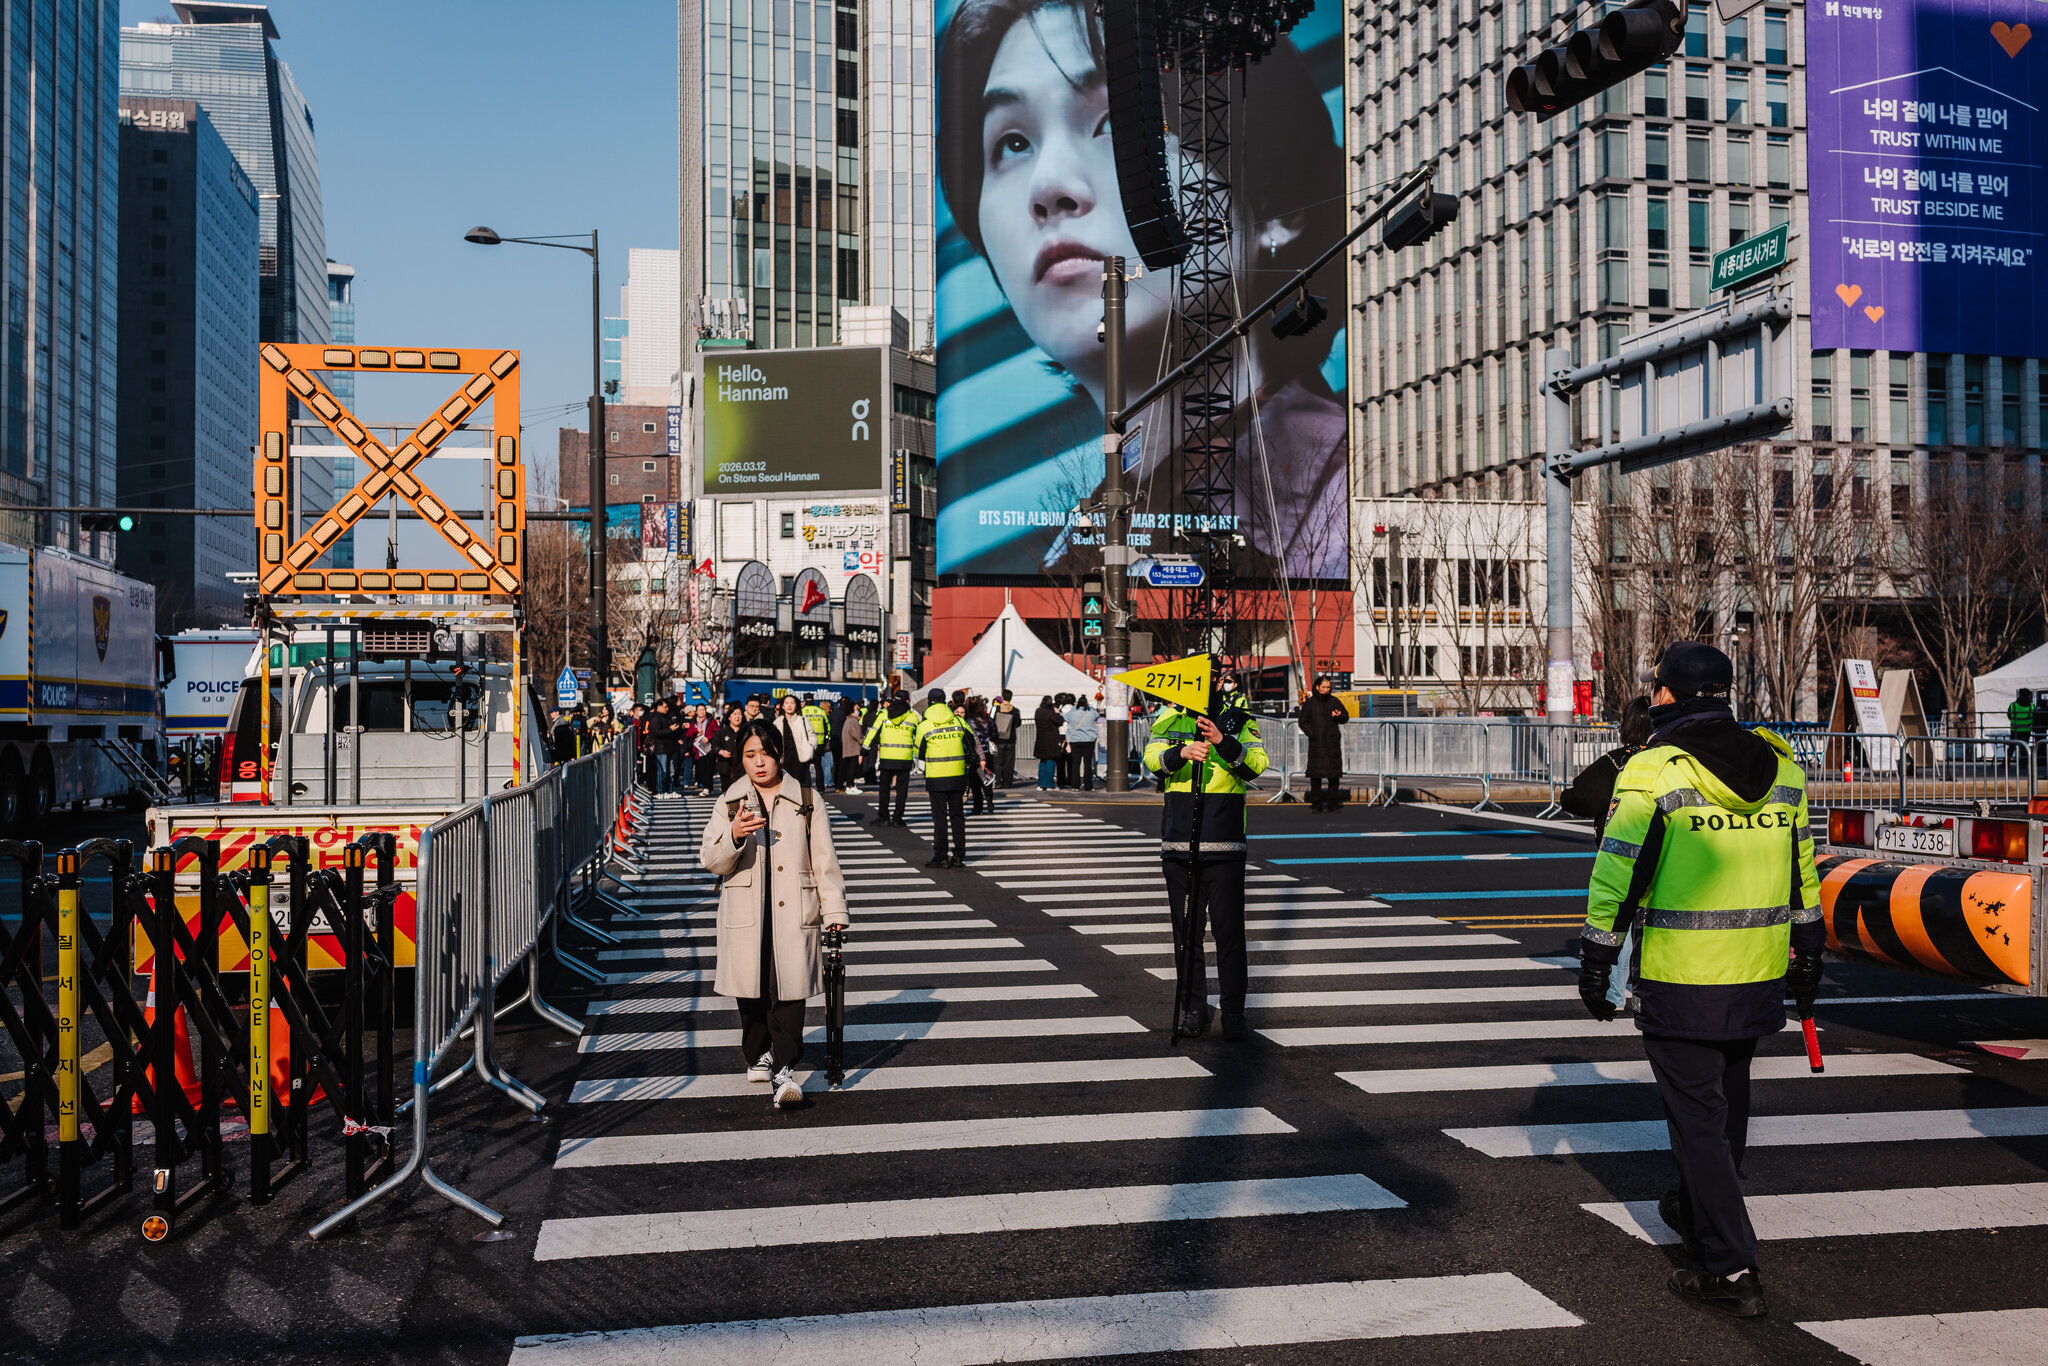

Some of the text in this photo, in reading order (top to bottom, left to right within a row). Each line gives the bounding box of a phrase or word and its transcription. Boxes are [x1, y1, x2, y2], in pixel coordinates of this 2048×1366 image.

[1842, 4, 1883, 20] 현대해상
[1863, 98, 2008, 131] 너의 곁에 나를 믿어
[1870, 129, 2003, 154] TRUST WITHIN ME
[1864, 166, 2009, 197] 나의 곁에 너를 믿어
[1871, 197, 2004, 221] TRUST BESIDE ME
[1718, 235, 1779, 279] 세종대로사거리
[1842, 236, 2033, 268] “서로의 안전을 지켜주세요”
[718, 364, 767, 385] Hello,
[718, 384, 789, 402] Hannam
[667, 414, 680, 452] 한의원
[718, 461, 767, 473] 2026.03.12
[718, 471, 820, 484] On Store Seoul Hannam
[979, 510, 1001, 526] BTS
[1003, 511, 1025, 527] 5TH
[1027, 511, 1066, 527] ALBUM
[1131, 513, 1156, 529] MAR
[860, 551, 884, 576] 약
[1162, 566, 1188, 574] 세종대로
[1084, 619, 1102, 636] 25
[898, 635, 909, 663] 약국
[187, 680, 239, 694] POLICE
[1145, 672, 1202, 692] 27기-1
[42, 684, 67, 706] POLICE
[932, 732, 963, 741] POLICE
[1688, 811, 1790, 832] POLICE
[1884, 829, 1944, 852] 91오 3238
[58, 934, 75, 1116] 질서유지선
[251, 931, 264, 1109] POLICE LINE
